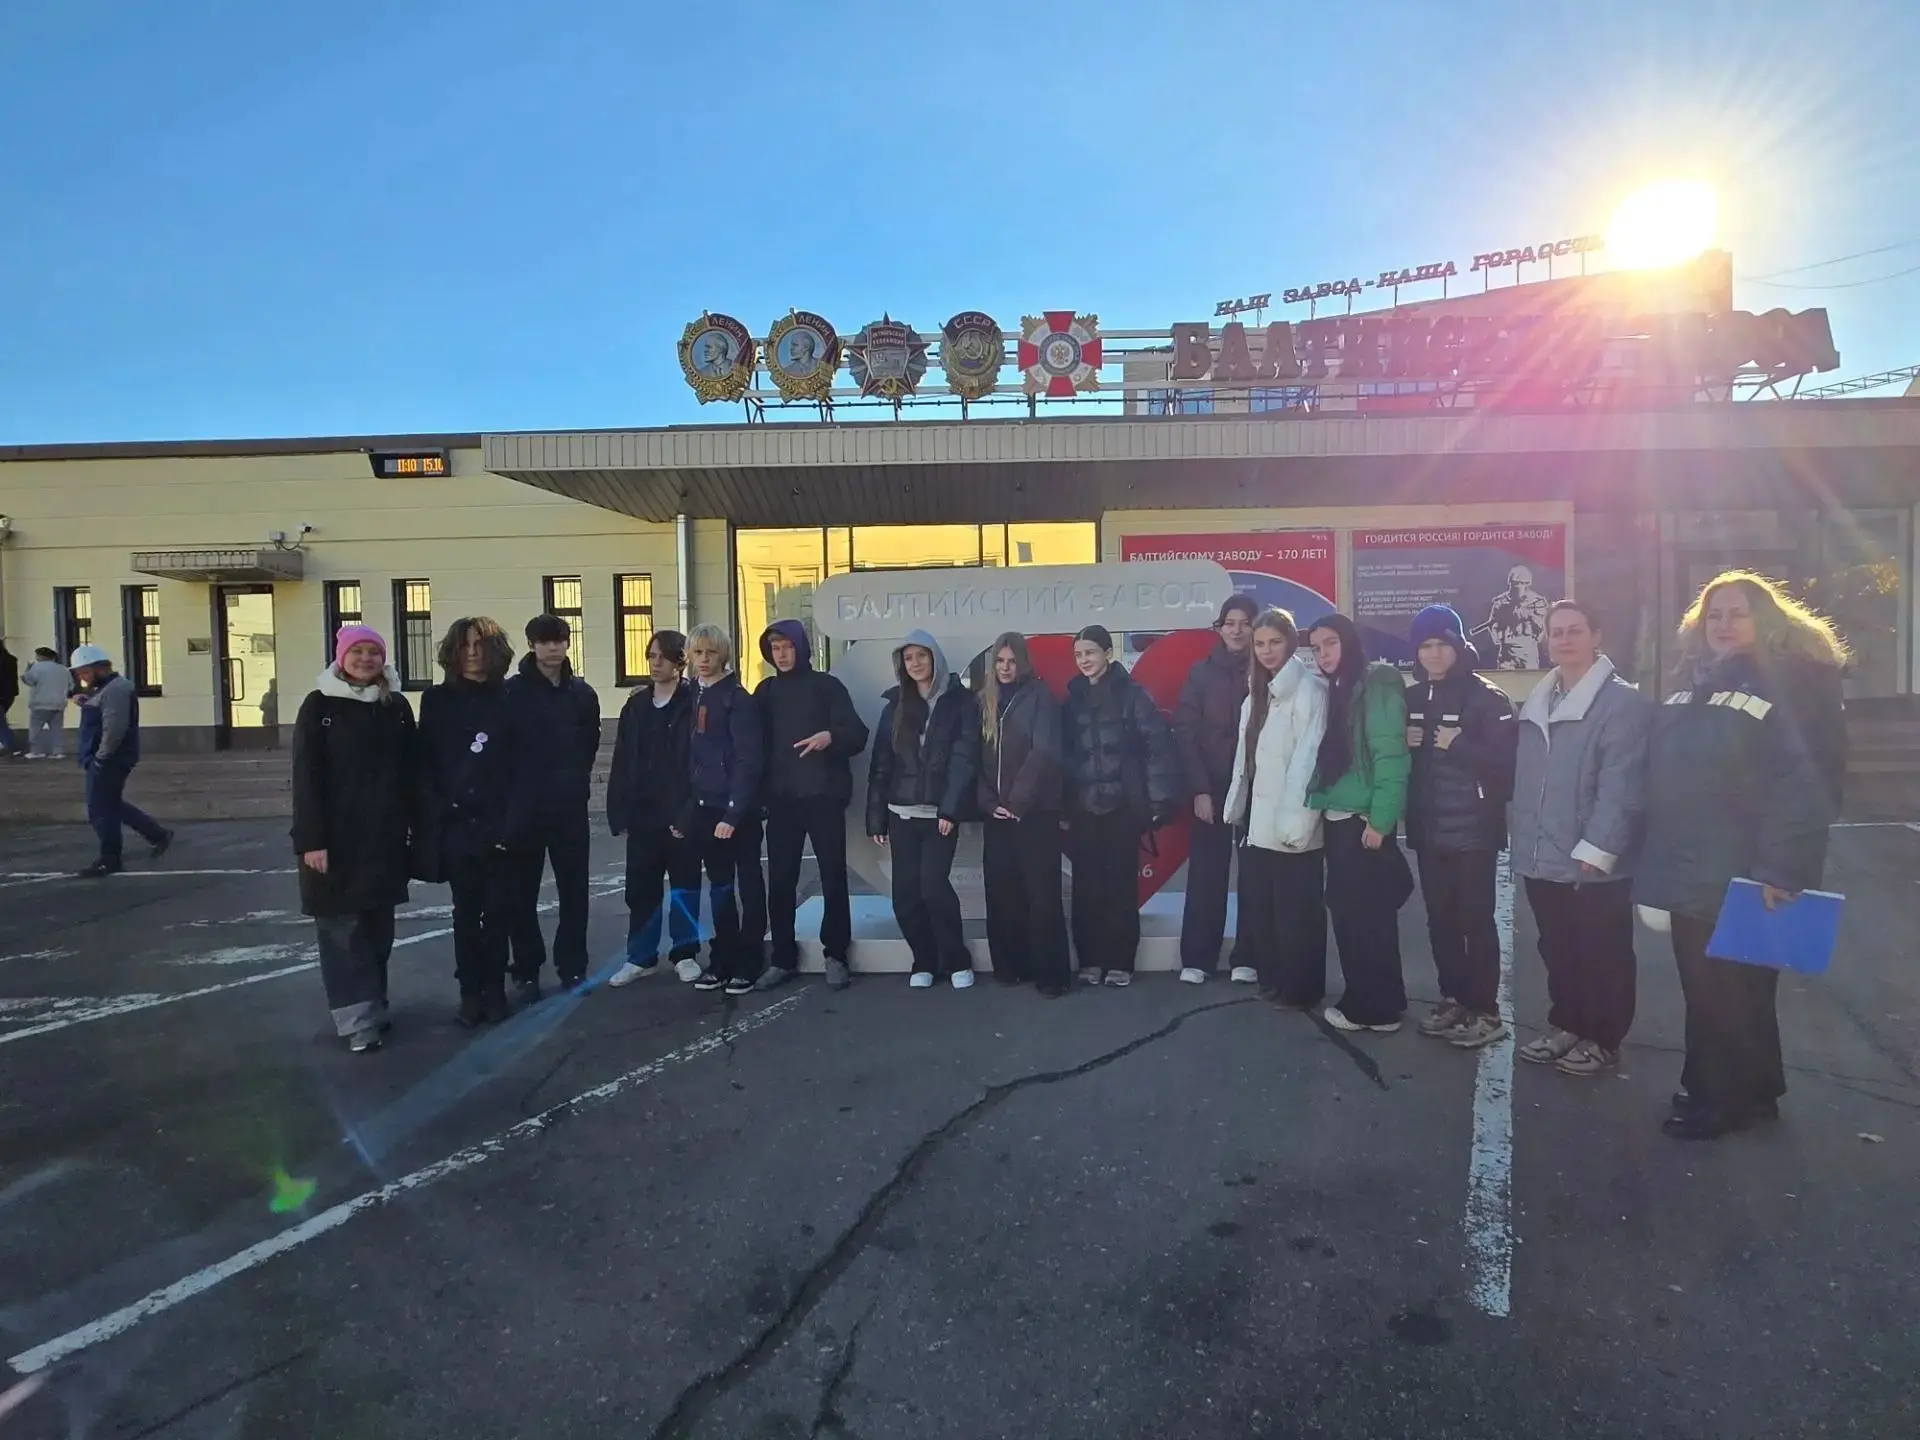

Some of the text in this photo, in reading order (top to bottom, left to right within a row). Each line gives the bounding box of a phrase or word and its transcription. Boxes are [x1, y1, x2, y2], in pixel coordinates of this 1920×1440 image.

[1214, 293, 1271, 316] НАШ
[1470, 235, 1605, 271] ГОРДОСТЬ
[711, 315, 743, 337] ЛЕНИН
[798, 314, 831, 337] ЛЕНИН
[953, 315, 991, 329] СССР
[1364, 529, 1553, 544] ГОРДИТСЯ РОССИЯ! ГОРДИТСЯ ЗАВОД!
[1129, 551, 1215, 562] БАЛТИЙСКОМУ
[1217, 550, 1262, 562] ЗАВОДУ
[1277, 549, 1298, 560] 170
[1301, 548, 1328, 560] ЛЕТ!
[836, 580, 1214, 621] БАЛТИЙСКИЙ ЗАВОД
